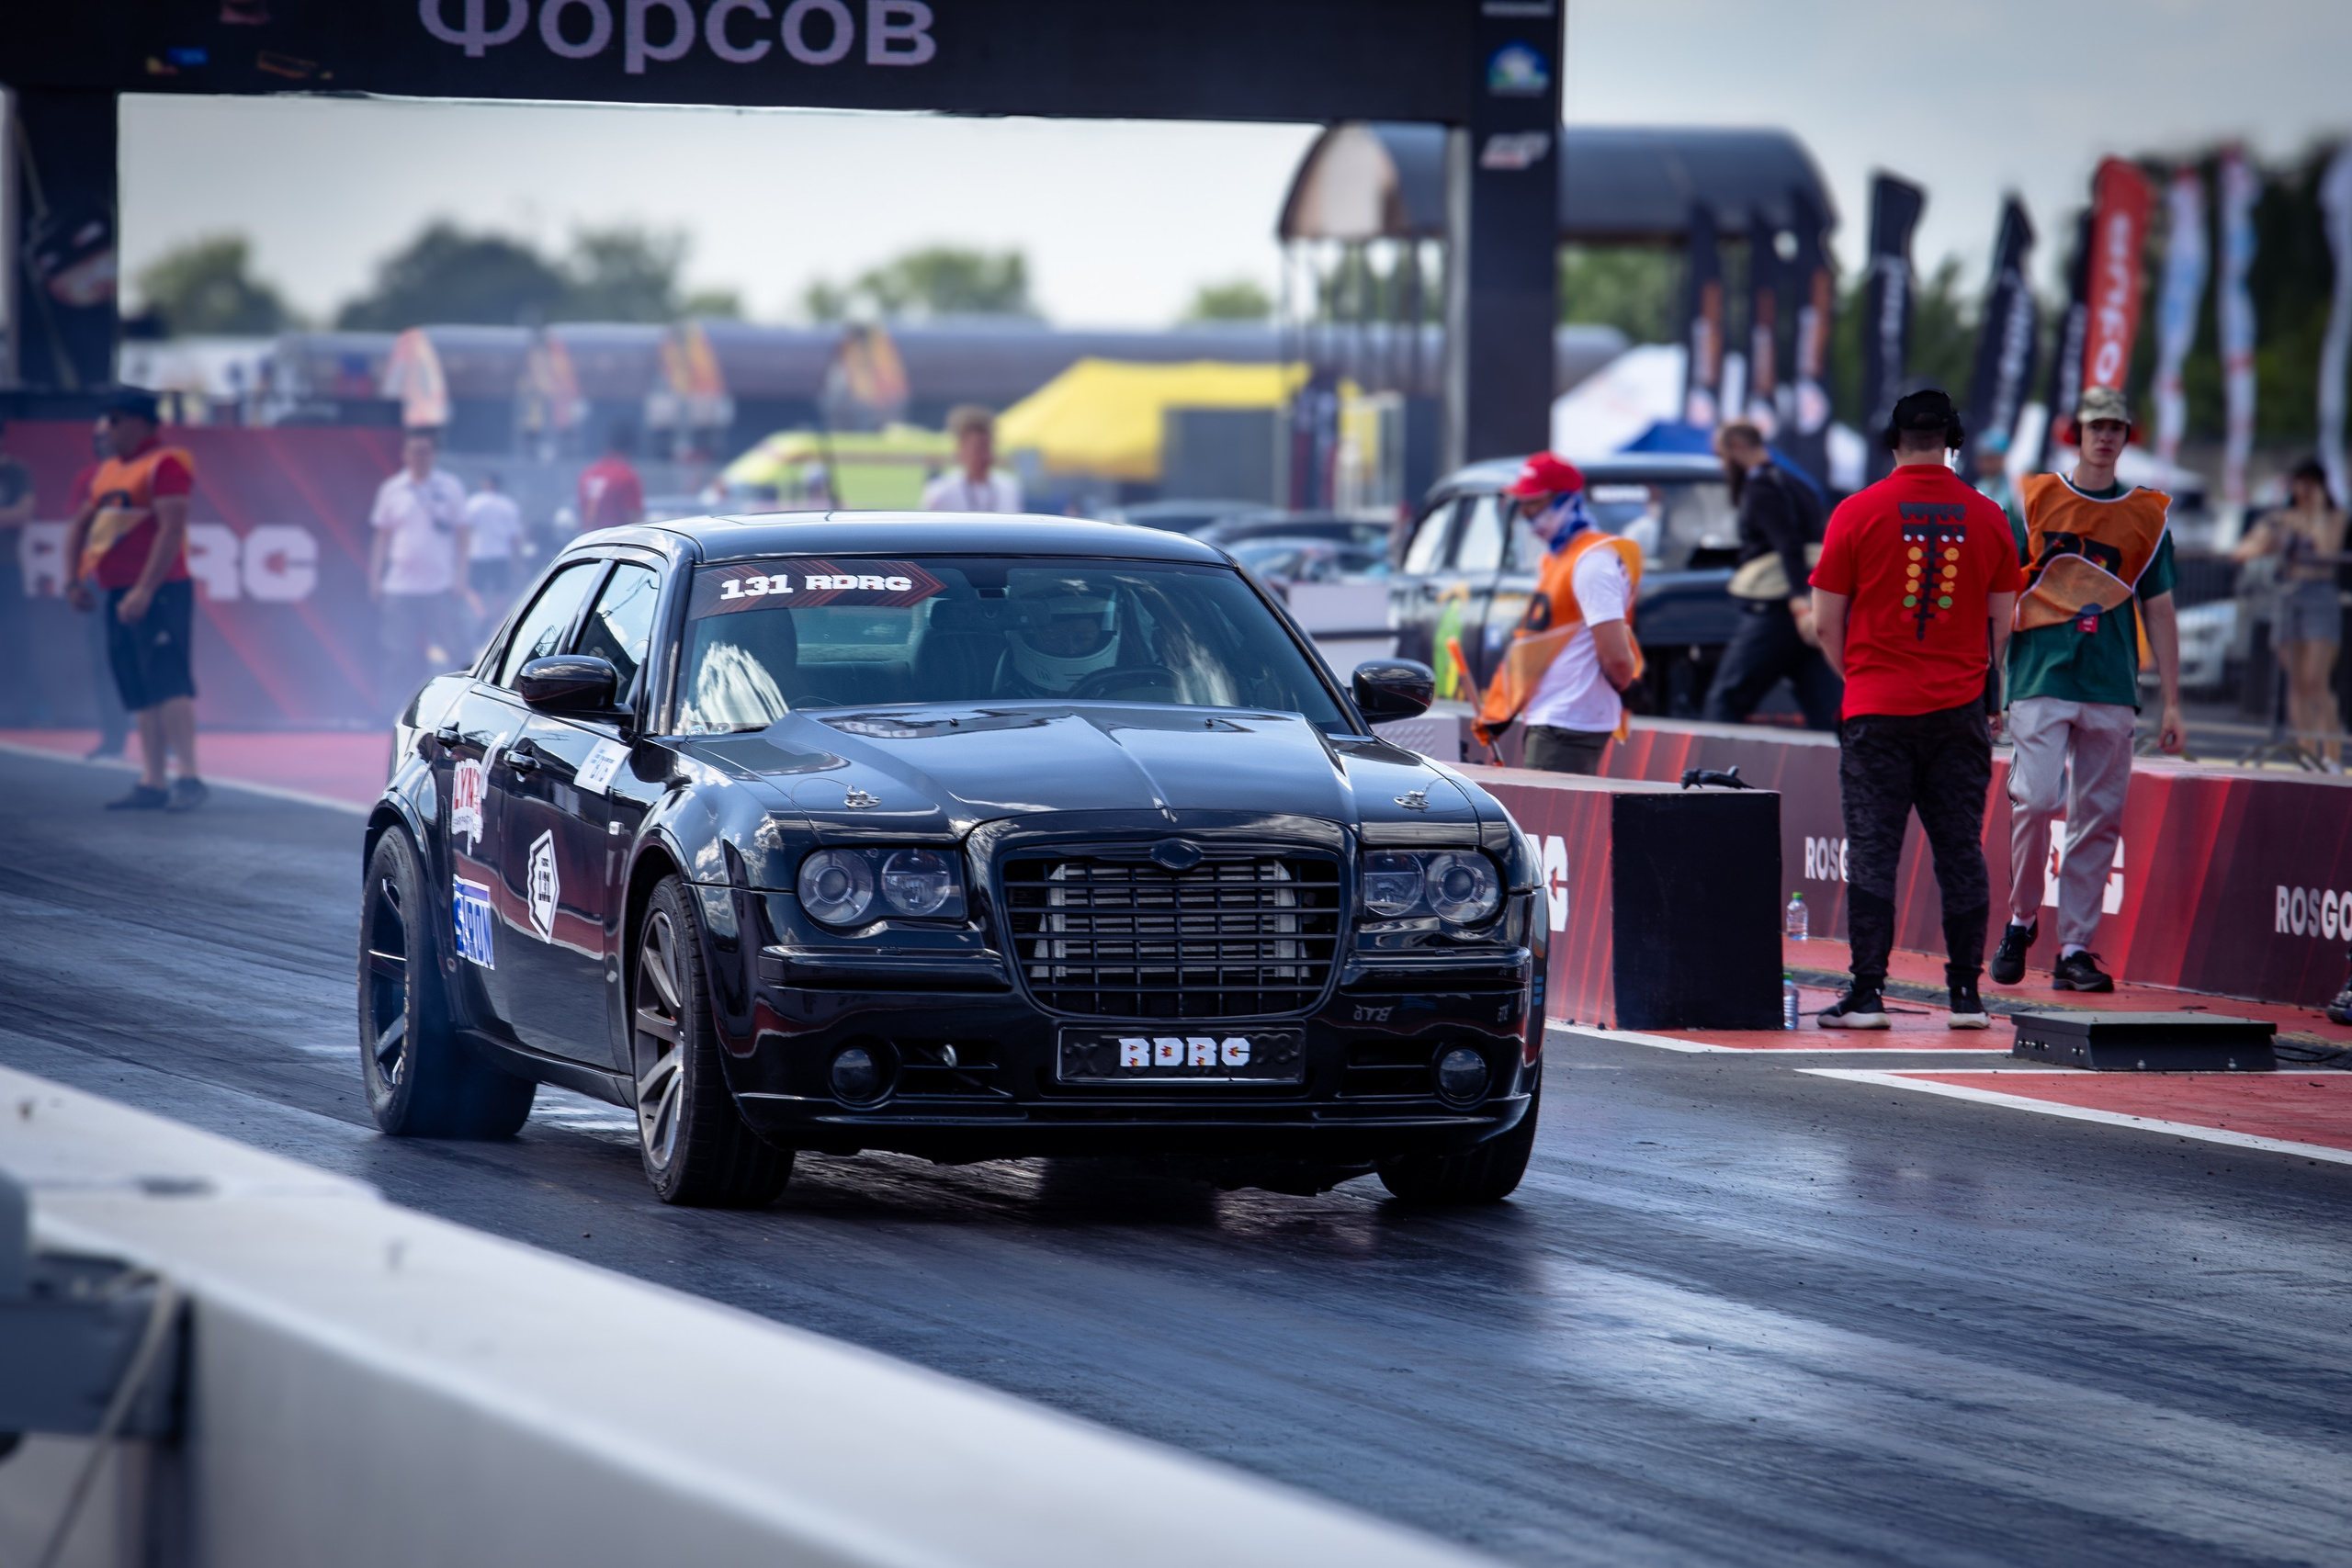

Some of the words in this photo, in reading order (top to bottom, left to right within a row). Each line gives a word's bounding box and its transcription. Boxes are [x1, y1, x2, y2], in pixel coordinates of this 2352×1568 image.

[418, 0, 936, 73] Форсов
[19, 521, 318, 601] RRC
[720, 574, 794, 600] 131
[805, 575, 912, 592] RDRC
[2275, 885, 2352, 942] ROSGO
[1118, 1037, 1250, 1066] RDRC
